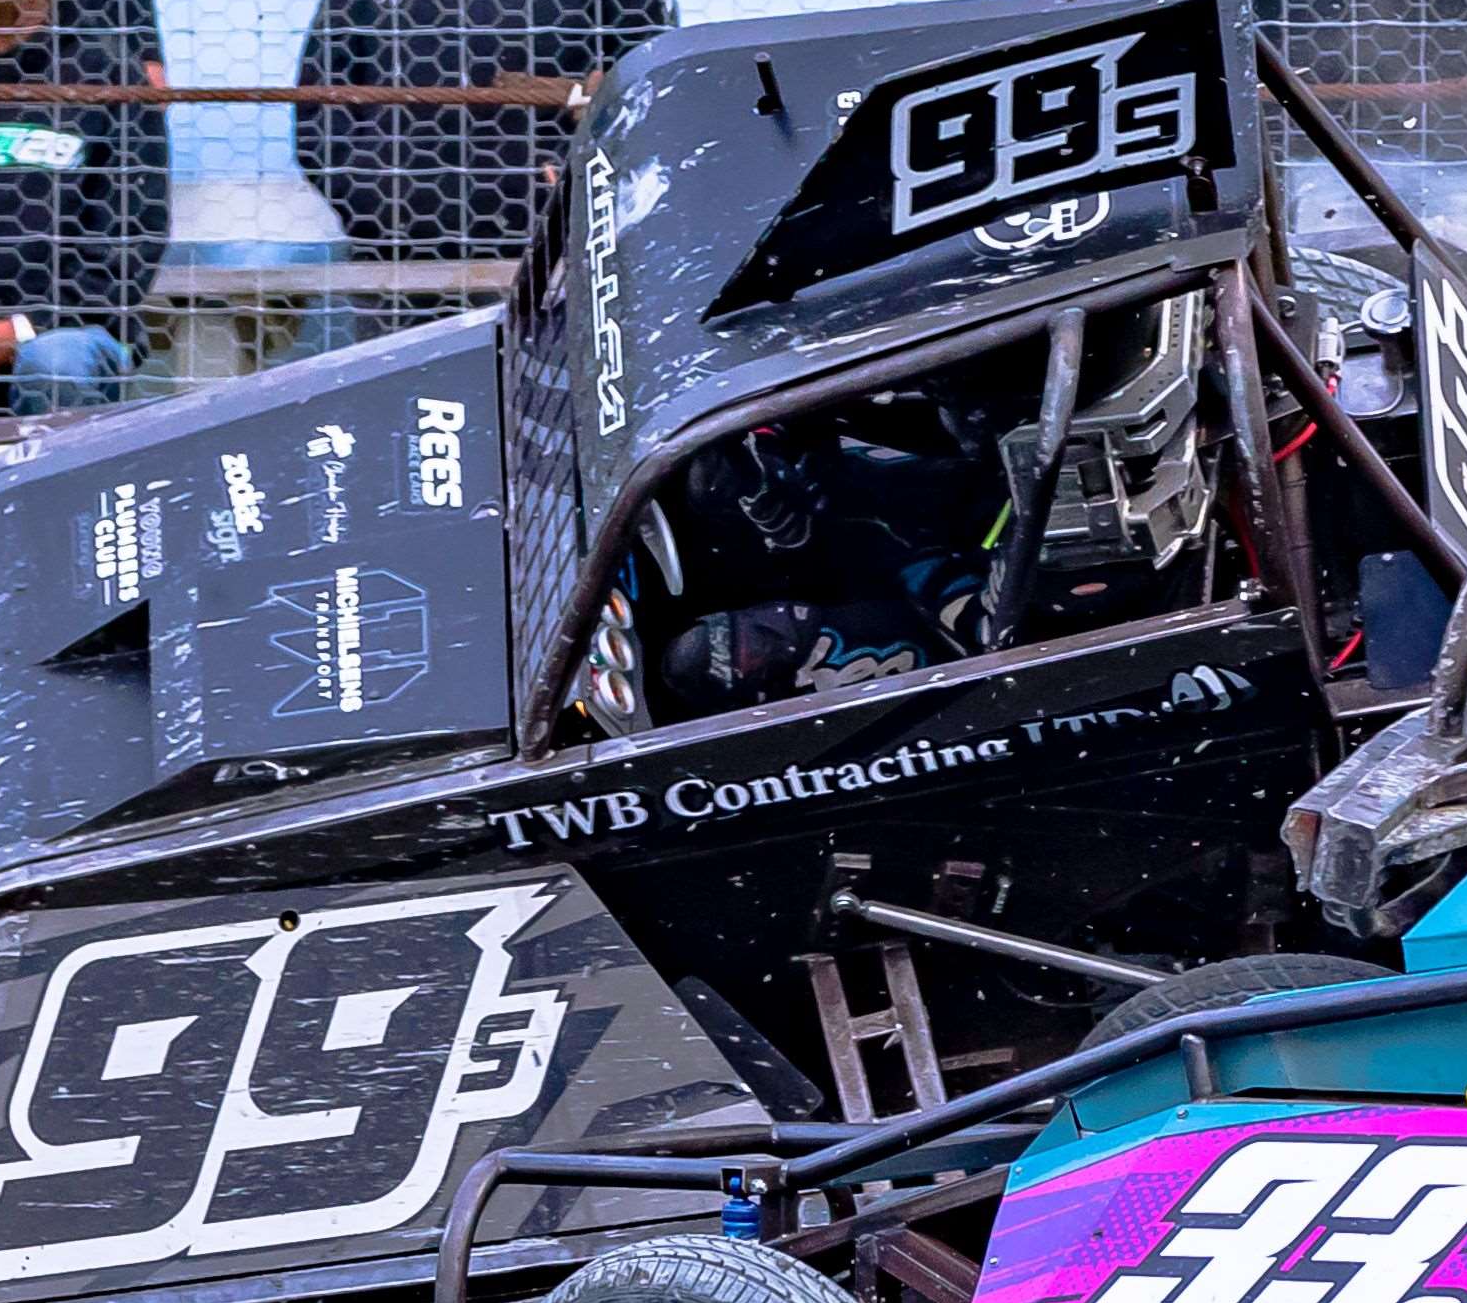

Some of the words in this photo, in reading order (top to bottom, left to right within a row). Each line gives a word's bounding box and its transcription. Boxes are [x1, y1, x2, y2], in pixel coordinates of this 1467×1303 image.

[892, 32, 1197, 234] 99s
[114, 483, 140, 602] PLUMBERS
[221, 453, 266, 535] zodiac
[94, 519, 117, 579] CLUB
[315, 591, 333, 700] TRANSPORT
[335, 567, 364, 713] MICHIELSENS
[488, 791, 649, 849] TWB
